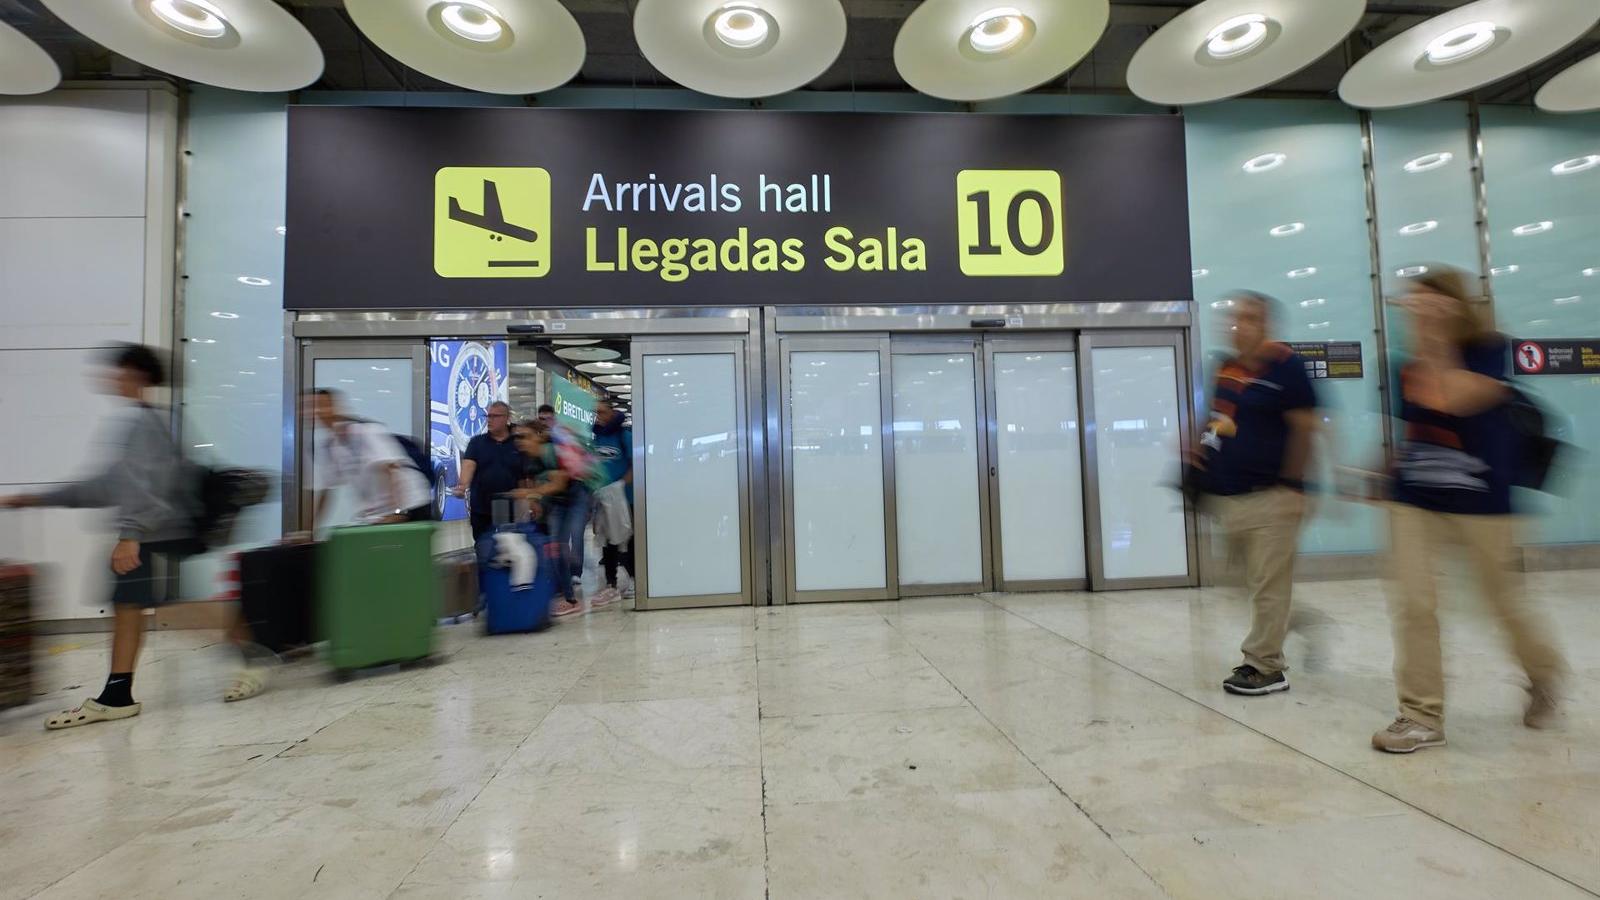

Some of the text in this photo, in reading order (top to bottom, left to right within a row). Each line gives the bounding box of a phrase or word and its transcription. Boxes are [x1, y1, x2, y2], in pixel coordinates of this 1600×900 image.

[583, 173, 832, 213] Arrivals hall
[967, 191, 1053, 255] 10
[586, 227, 927, 282] Llegadas Sala
[563, 400, 593, 425] BREITLING
